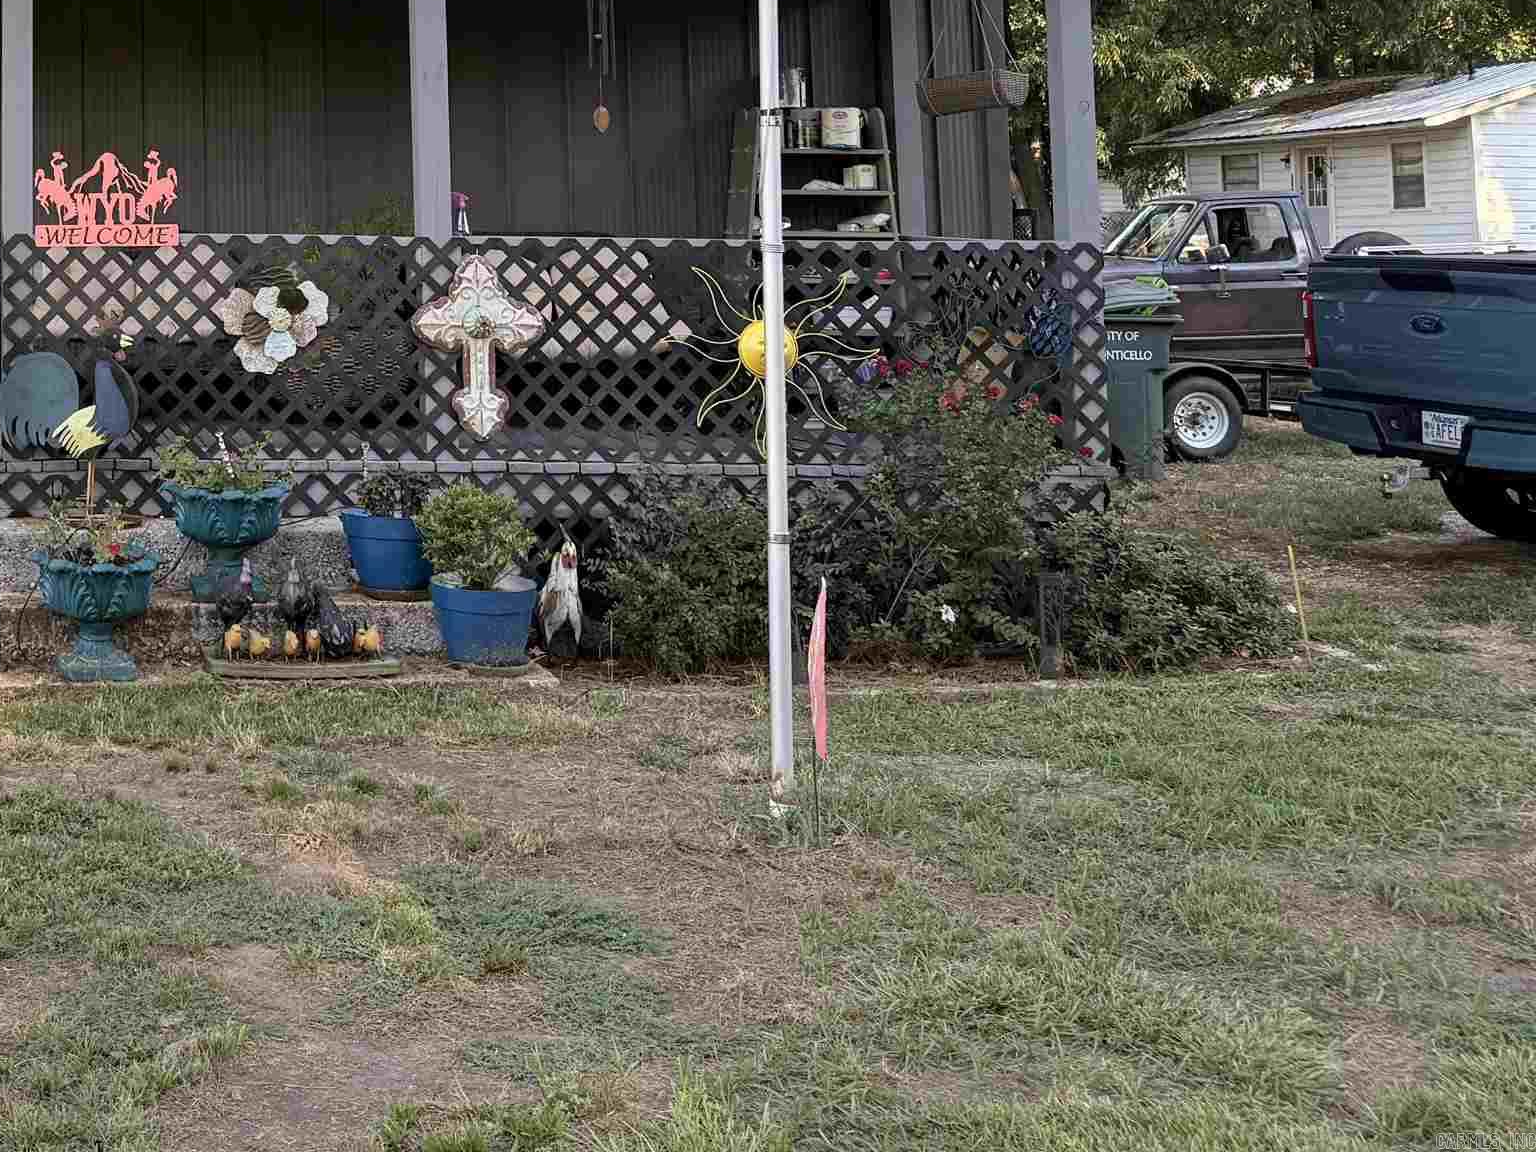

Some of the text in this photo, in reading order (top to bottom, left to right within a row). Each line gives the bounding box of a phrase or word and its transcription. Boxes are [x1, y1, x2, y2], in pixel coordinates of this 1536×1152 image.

[73, 192, 137, 226] WYO
[45, 226, 170, 245] WELCOME
[1106, 330, 1140, 341] ITY OF
[1104, 350, 1153, 361] NTICELLO
